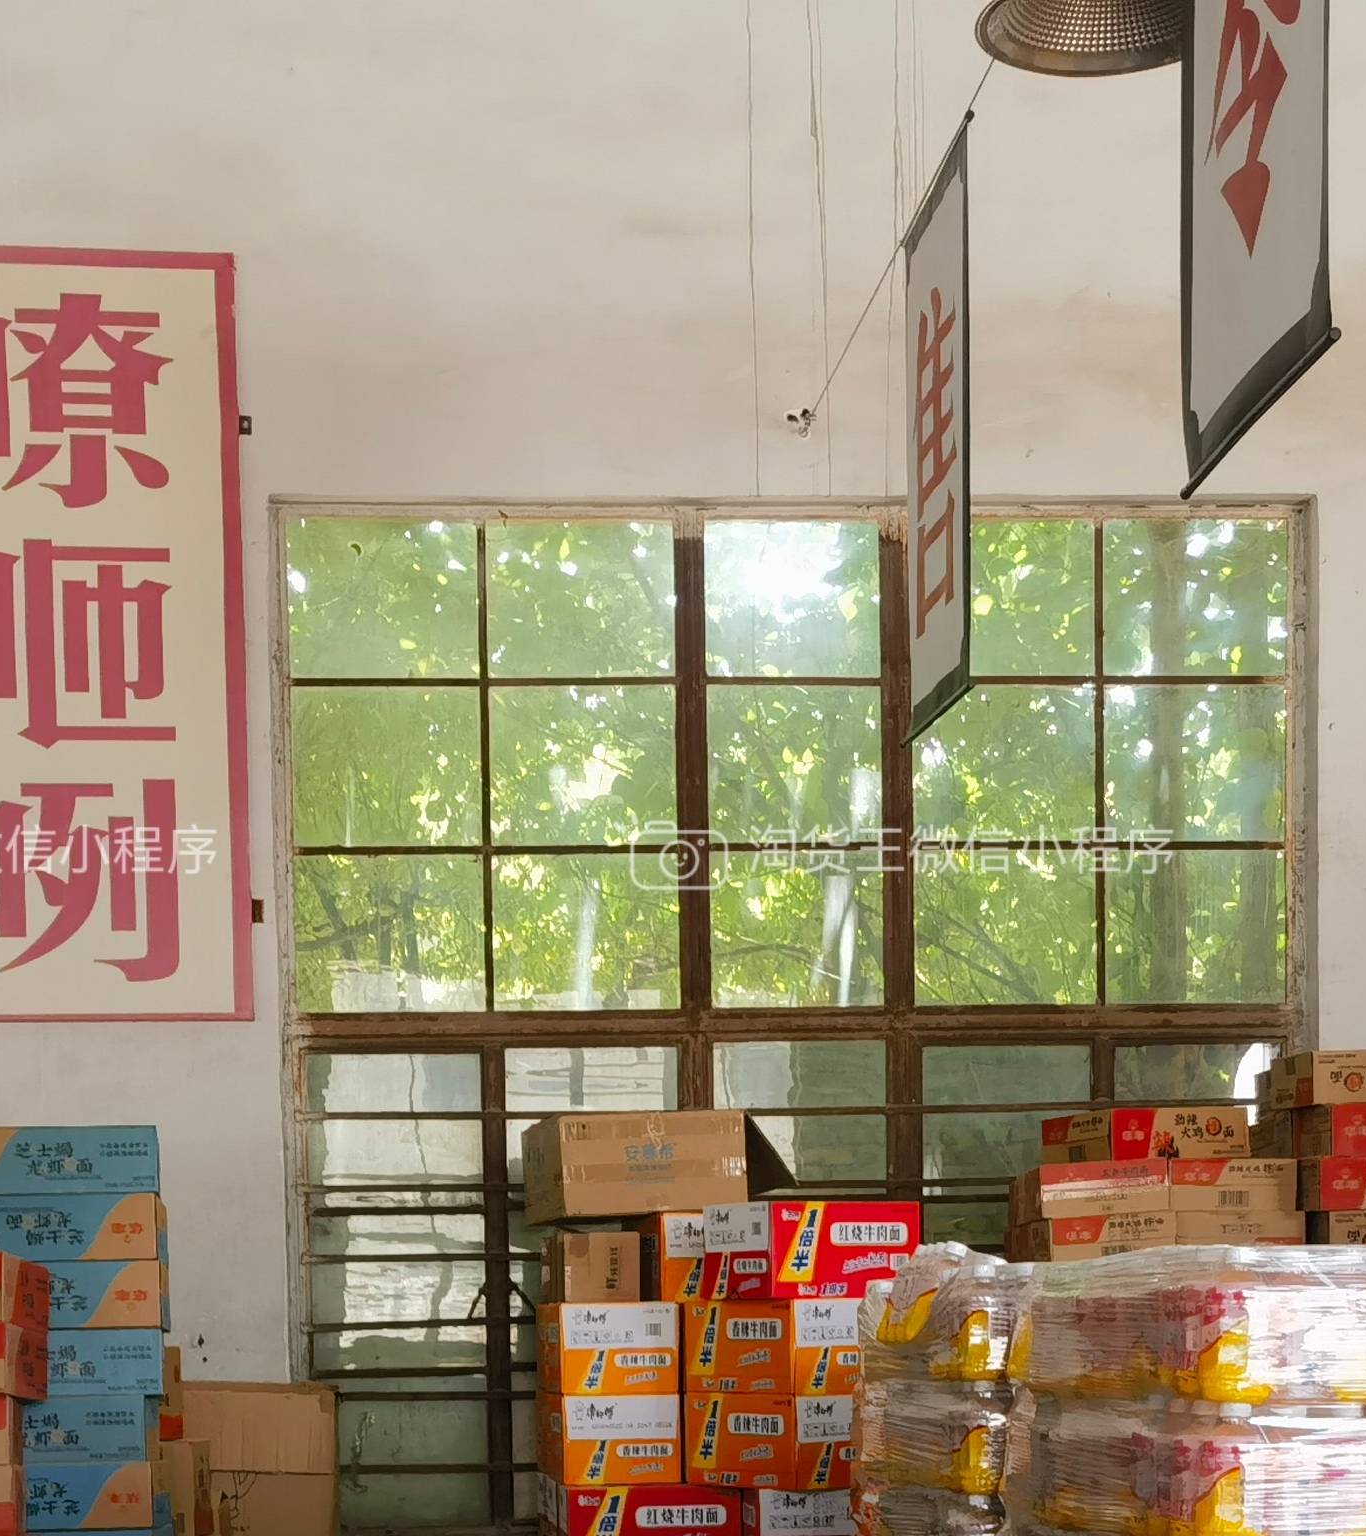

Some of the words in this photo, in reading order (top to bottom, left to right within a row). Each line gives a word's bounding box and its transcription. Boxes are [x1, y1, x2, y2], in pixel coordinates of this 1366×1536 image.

[838, 1224, 904, 1242] 红烧牛肉面
[646, 1505, 719, 1526] 红烧牛肉面
